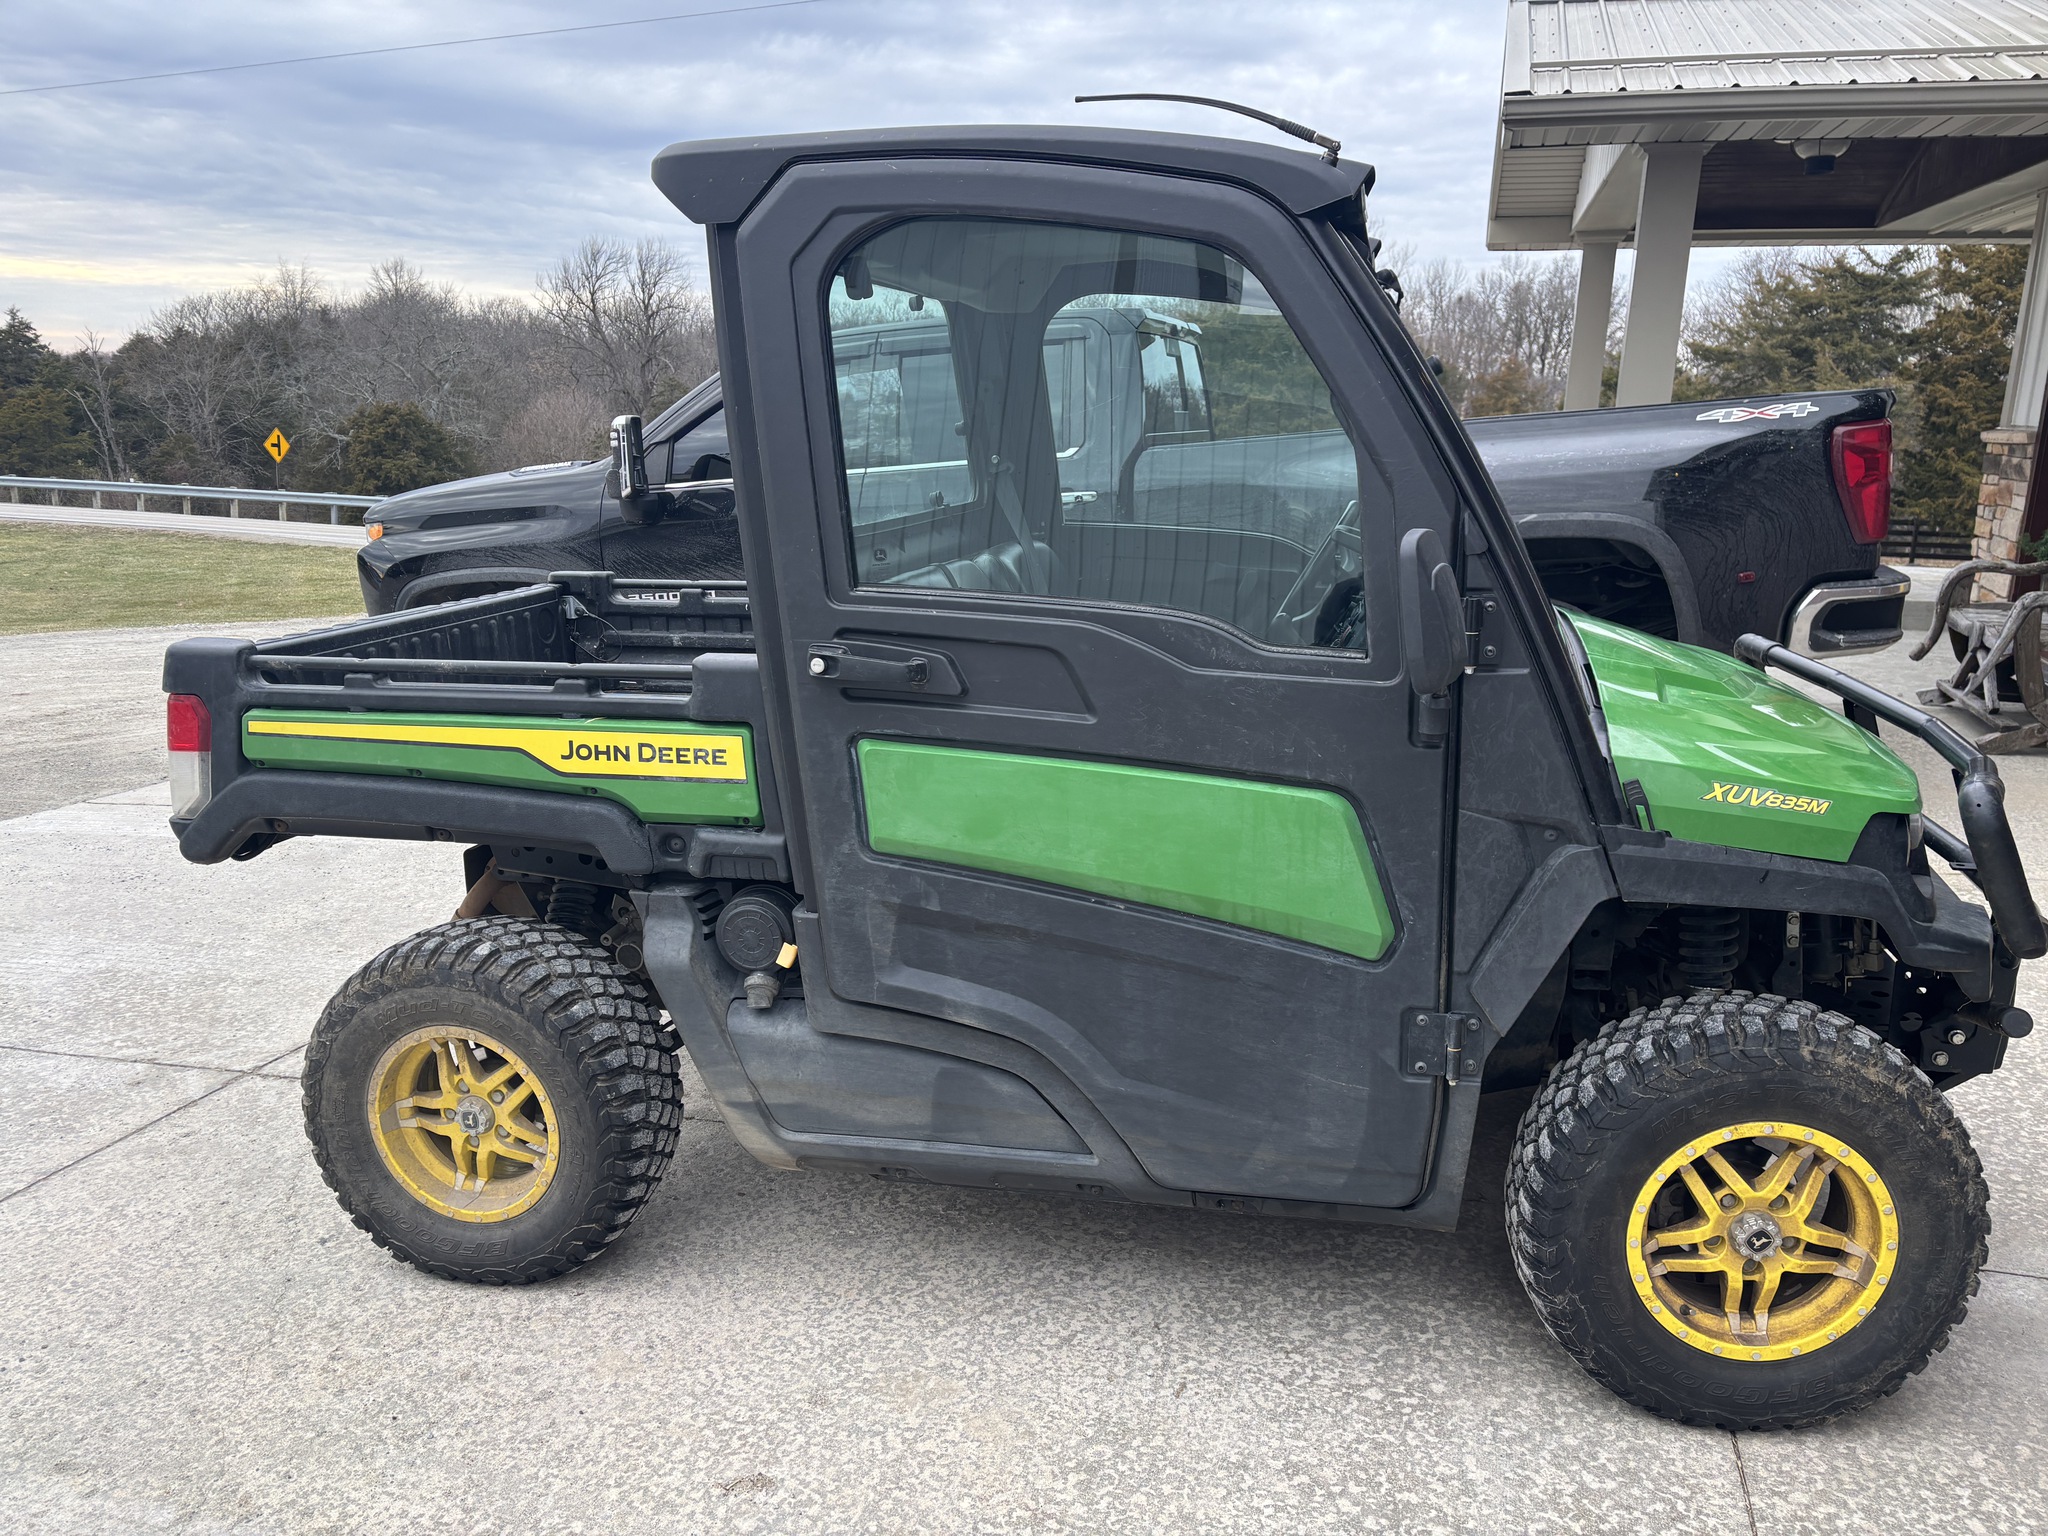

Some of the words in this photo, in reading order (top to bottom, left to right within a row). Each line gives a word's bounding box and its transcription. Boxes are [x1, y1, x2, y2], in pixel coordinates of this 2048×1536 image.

[561, 740, 630, 762] JOHN
[637, 743, 727, 766] DEERE
[1700, 782, 1829, 815] XUV835M
[336, 1127, 509, 1257] BFGoodrich
[1593, 1274, 1836, 1404] BFGoodrich
